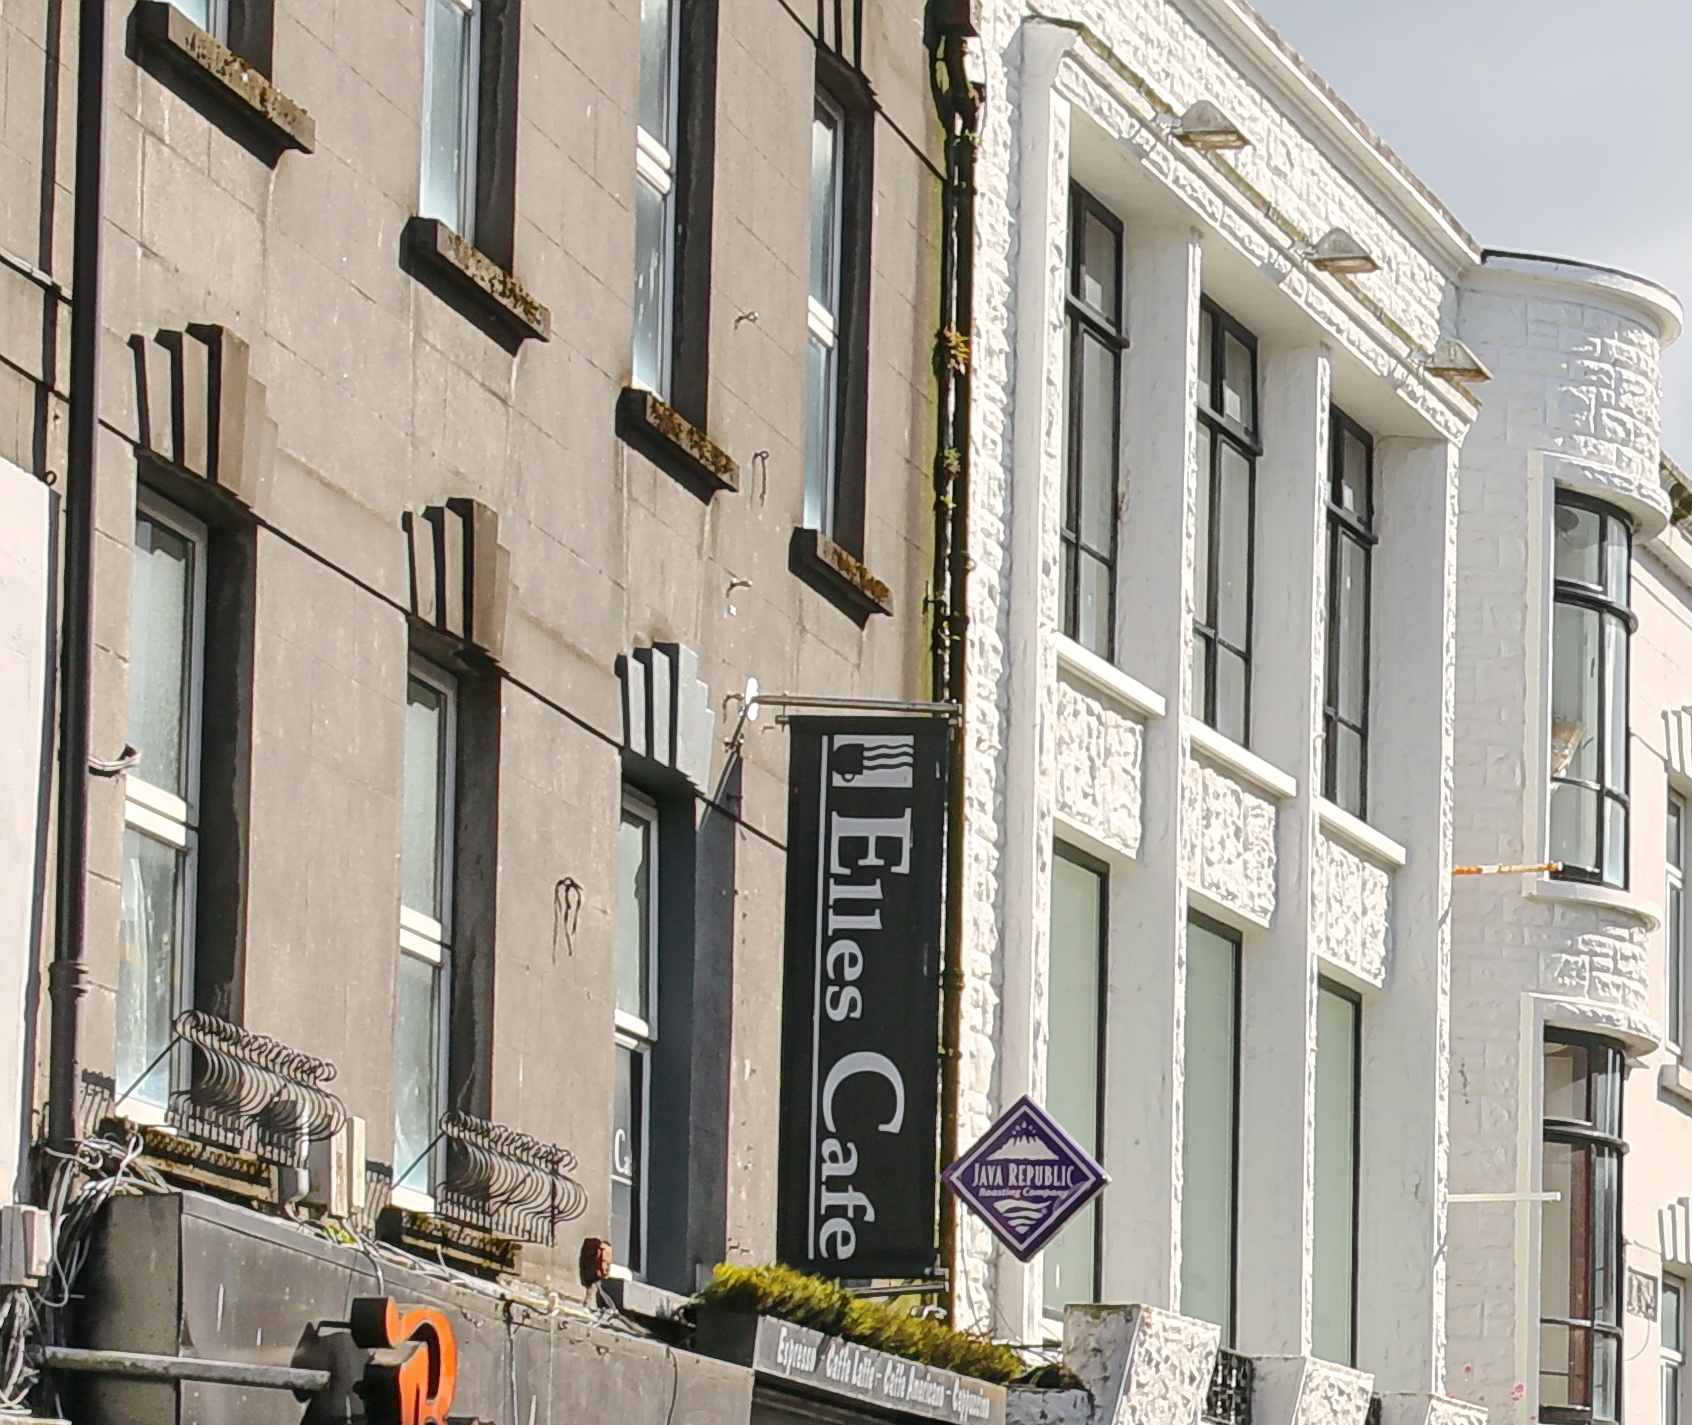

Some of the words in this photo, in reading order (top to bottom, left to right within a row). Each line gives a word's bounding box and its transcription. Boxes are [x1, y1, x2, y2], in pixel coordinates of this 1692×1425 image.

[825, 807, 912, 1022] Elles
[819, 1050, 906, 1260] Cafe
[972, 1163, 1004, 1187] JAVA
[1008, 1163, 1075, 1188] REPUBLIC
[978, 1188, 1021, 1198] Roasting
[1022, 1188, 1069, 1198] Company
[777, 1326, 817, 1376] Espresso
